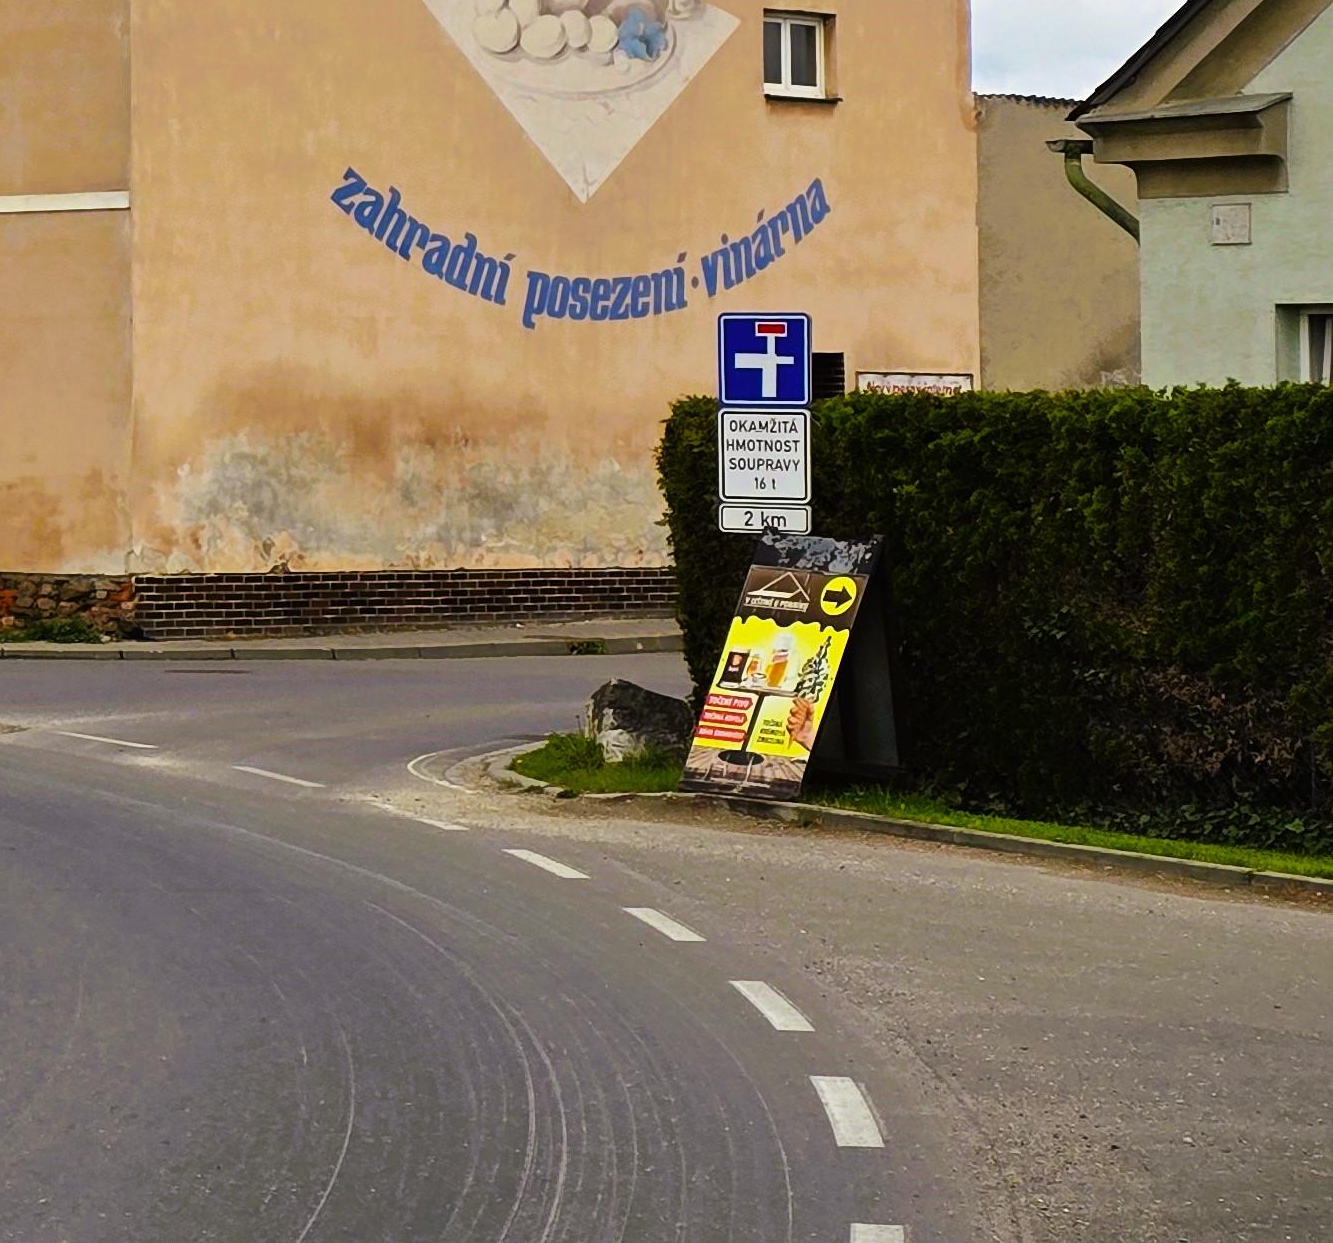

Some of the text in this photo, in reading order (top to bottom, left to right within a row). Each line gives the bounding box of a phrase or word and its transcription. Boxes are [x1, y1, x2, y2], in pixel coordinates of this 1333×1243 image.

[522, 251, 688, 330] posezení
[700, 177, 831, 298] vinárna
[729, 418, 799, 434] OKAMŽITÁ
[726, 438, 801, 453] HMOTNOST
[728, 457, 801, 472] SOUPRAVY
[754, 476, 767, 490] 16
[743, 510, 787, 528] 2 km
